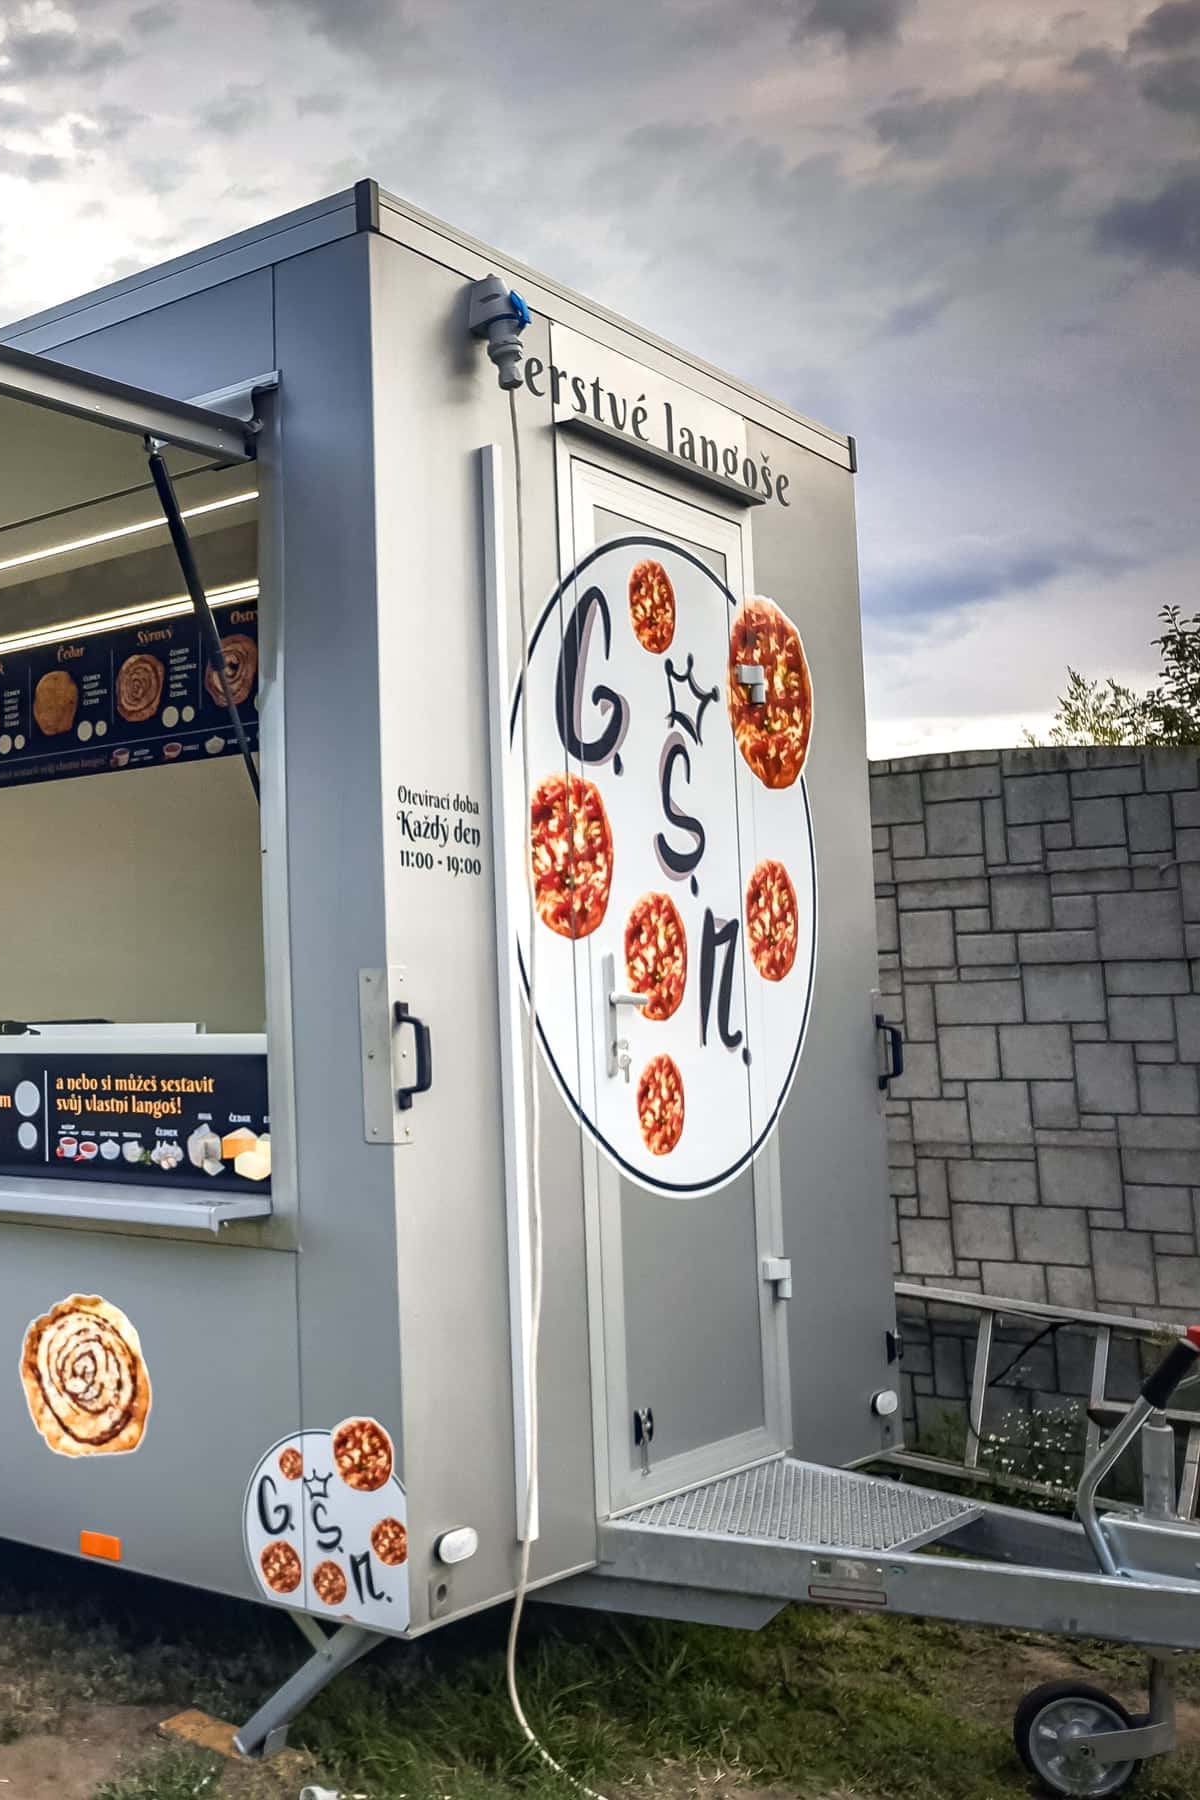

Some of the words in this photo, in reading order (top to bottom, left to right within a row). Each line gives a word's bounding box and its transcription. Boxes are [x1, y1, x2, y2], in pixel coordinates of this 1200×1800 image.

[524, 357, 649, 442] erstvé
[664, 402, 790, 507] langoše
[453, 793, 480, 815] doba
[396, 811, 449, 848] Každý
[454, 818, 481, 848] den
[400, 850, 434, 869] 11:00
[447, 856, 482, 877] 19:00
[56, 1077, 64, 1090] a
[66, 1073, 98, 1092] nebo
[101, 1074, 112, 1091] si
[115, 1073, 157, 1092] můžeš
[160, 1076, 215, 1094] sestavit
[56, 1094, 82, 1115] svůj
[85, 1094, 129, 1114] vlastní
[132, 1095, 183, 1119] langoš!
